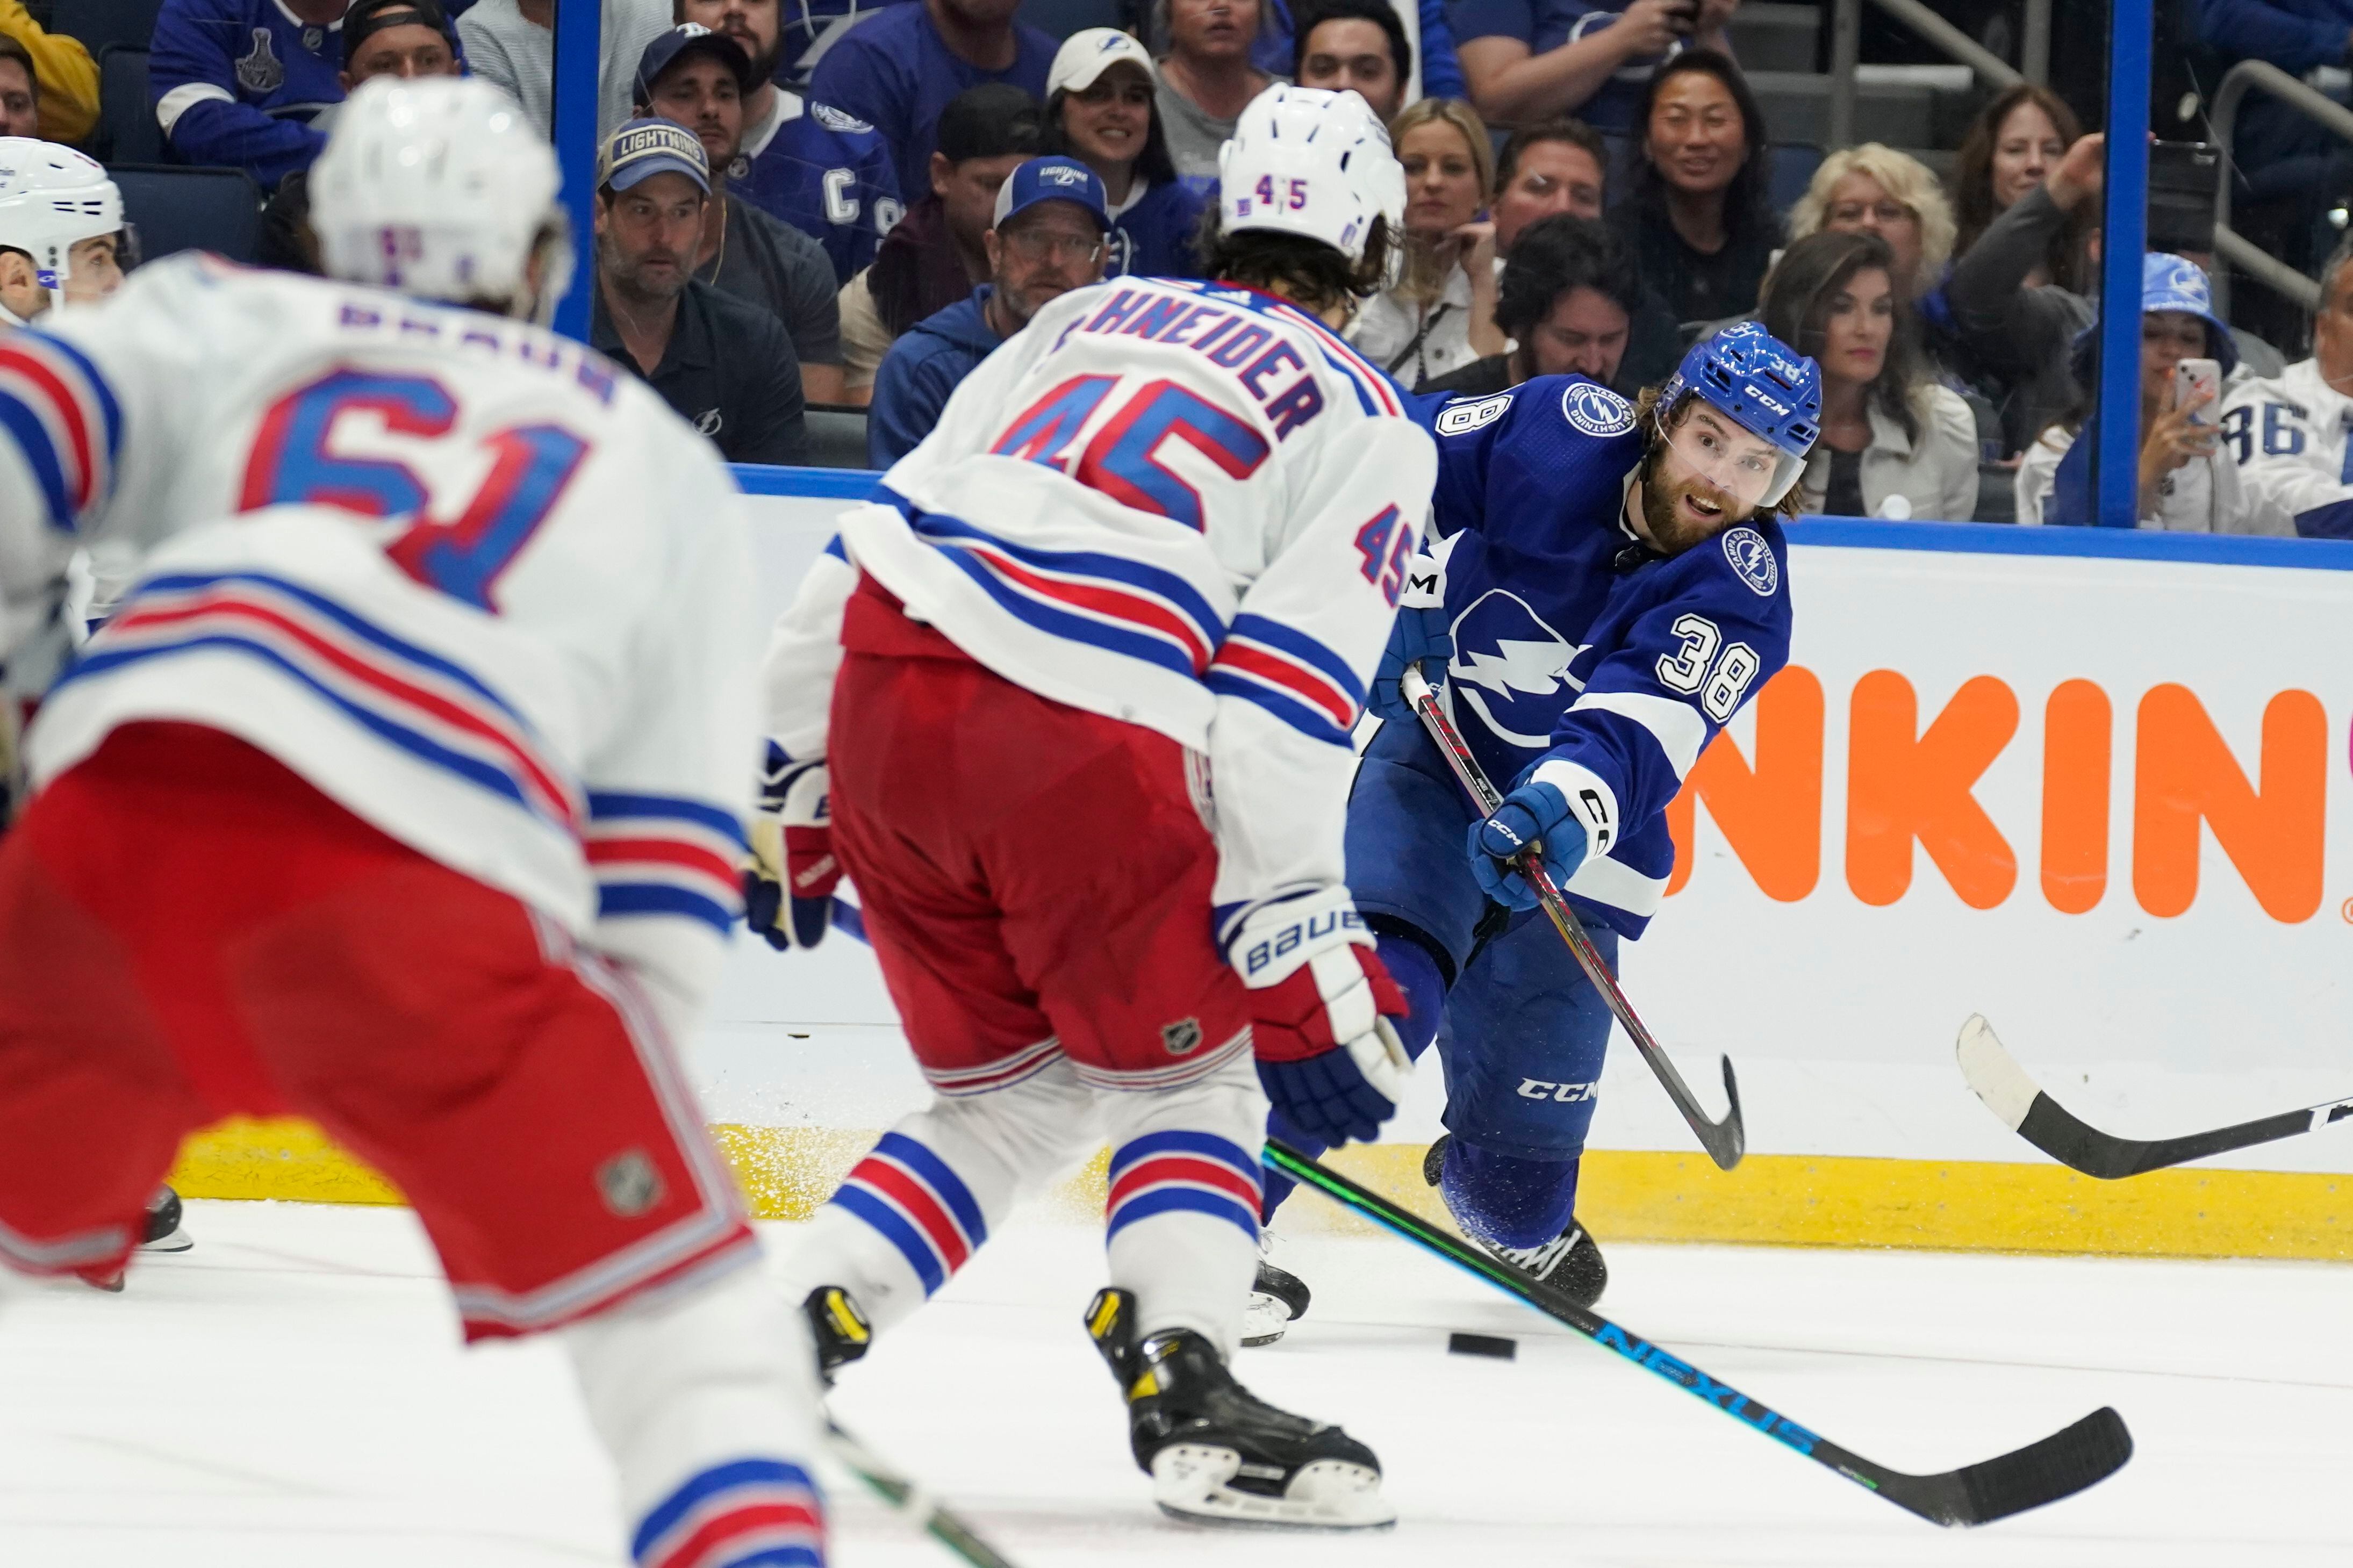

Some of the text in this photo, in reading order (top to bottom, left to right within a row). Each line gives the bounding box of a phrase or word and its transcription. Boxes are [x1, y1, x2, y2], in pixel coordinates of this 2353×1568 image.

[621, 130, 701, 161] LIGHTNING
[822, 168, 860, 225] C
[1255, 174, 1308, 210] 45
[1595, 387, 1627, 409] TAMPA
[1745, 384, 1790, 416] CCM
[1570, 409, 1626, 433] LIGHTNING
[233, 364, 594, 617] 61
[1732, 531, 1749, 541] BAY
[1354, 502, 1414, 608] 45
[1727, 539, 1742, 568] TAMPA
[1752, 534, 1775, 586] LIGHTNING
[1655, 613, 1761, 724] 38
[1487, 819, 1523, 846] CCM
[1517, 1077, 1600, 1102] CCM
[1595, 1321, 1822, 1456] NEXUS
